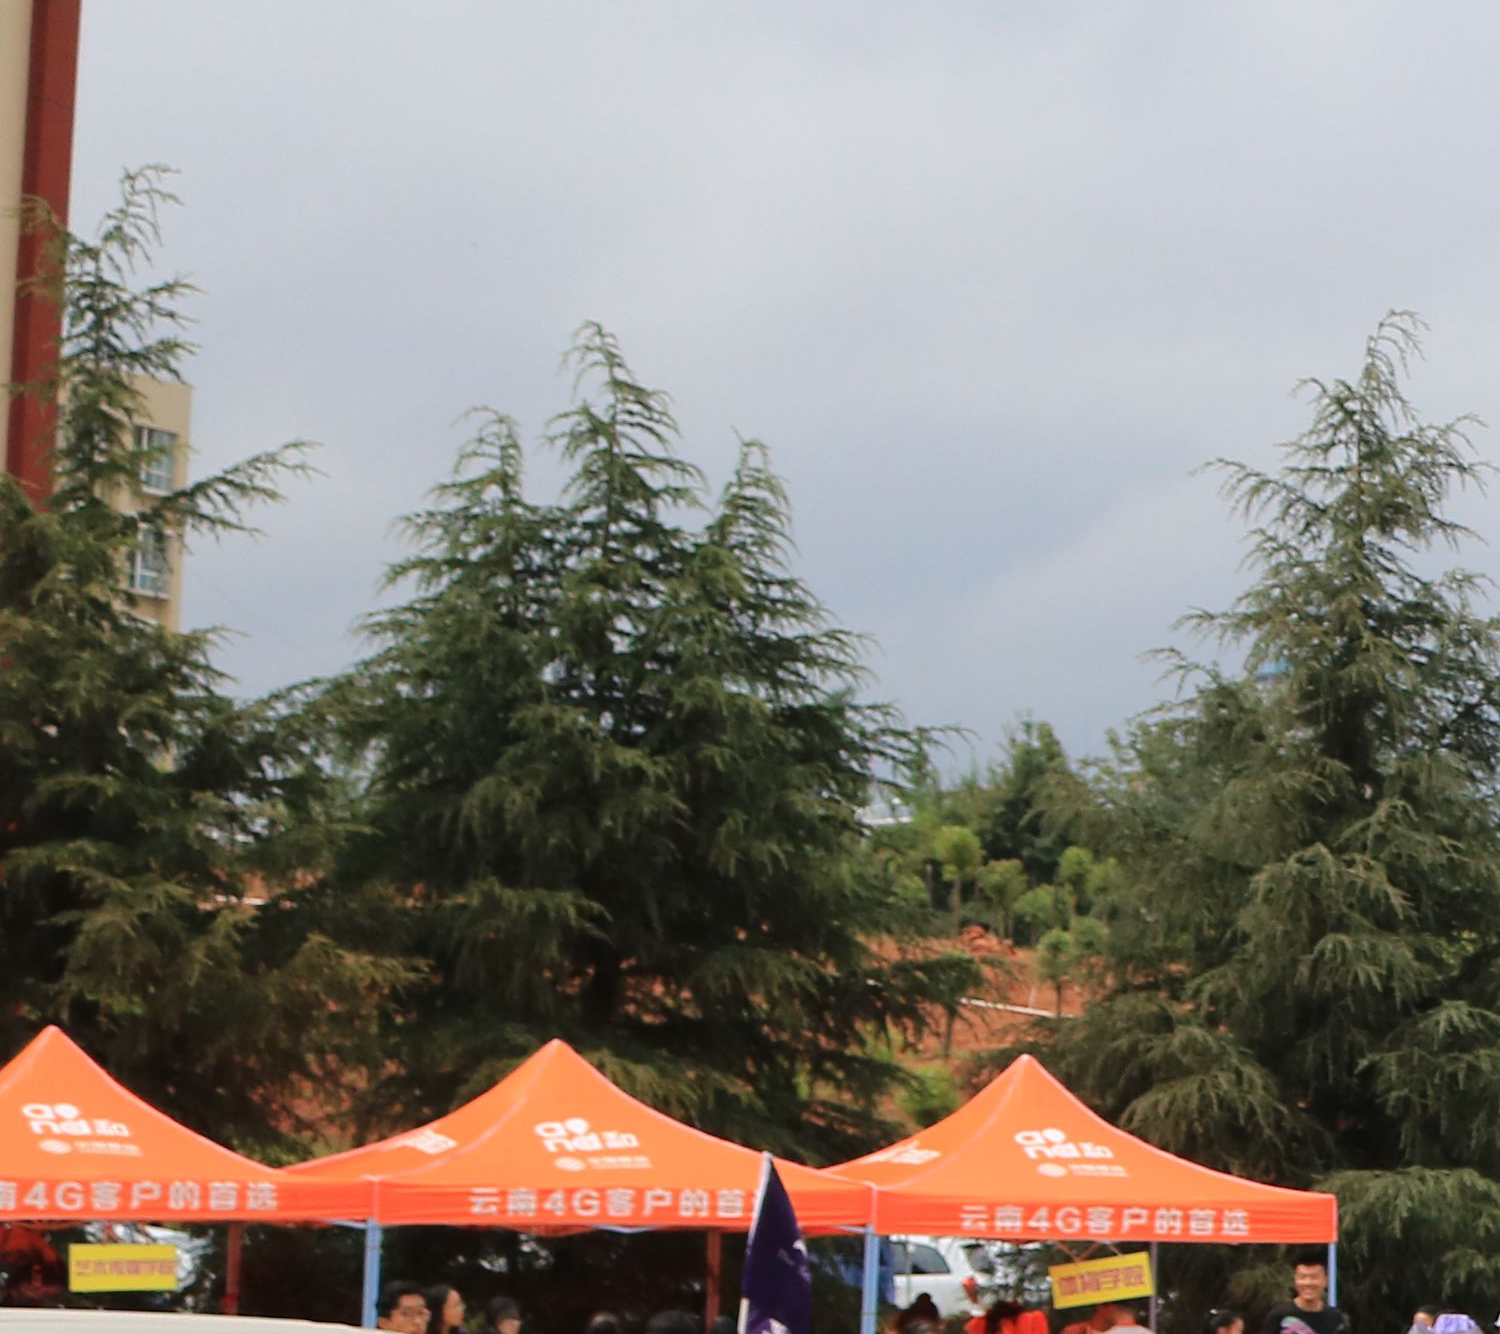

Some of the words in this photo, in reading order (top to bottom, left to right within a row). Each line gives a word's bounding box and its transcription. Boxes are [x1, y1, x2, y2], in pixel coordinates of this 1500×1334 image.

[469, 1187, 761, 1218] 云南4G客户的首
[960, 1204, 1250, 1237] 云南4G客户的首选
